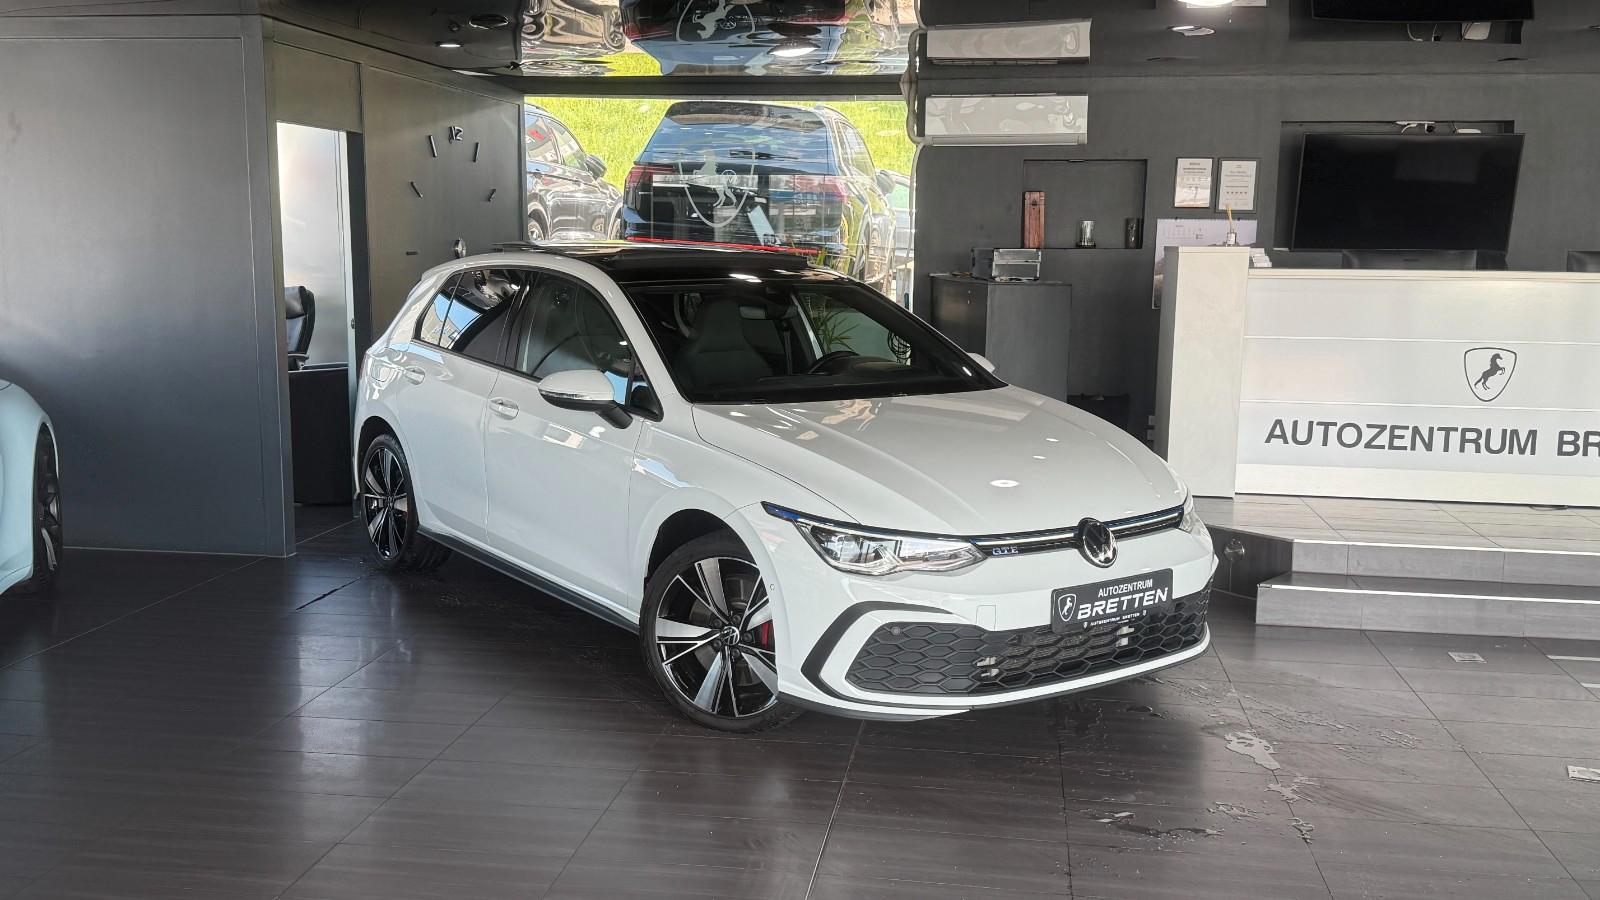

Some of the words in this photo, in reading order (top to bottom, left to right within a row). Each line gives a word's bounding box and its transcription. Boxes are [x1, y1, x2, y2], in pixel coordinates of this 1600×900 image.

[449, 126, 463, 141] 12
[1264, 418, 1538, 456] AUTOZENTRUM
[1098, 578, 1153, 598] AUTOZENTRUM
[1077, 587, 1169, 620] BRETTEN
